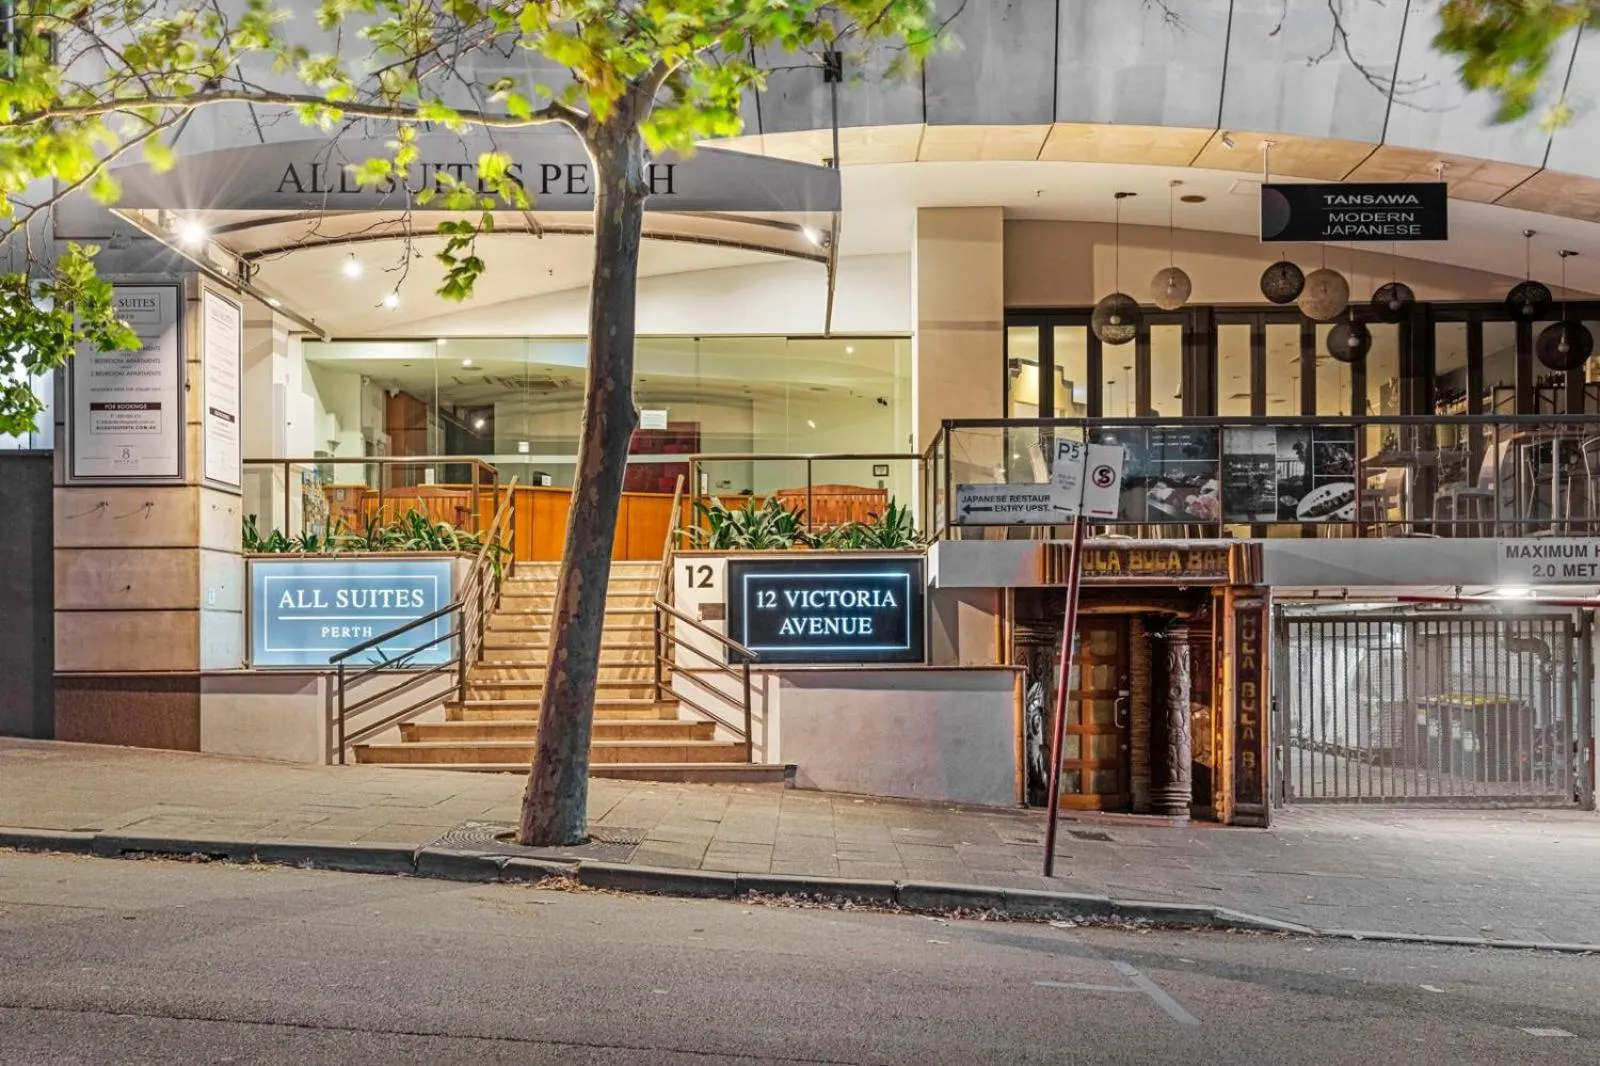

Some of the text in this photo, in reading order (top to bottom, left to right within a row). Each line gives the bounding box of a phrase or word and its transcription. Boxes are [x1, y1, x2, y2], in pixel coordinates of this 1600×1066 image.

[275, 162, 362, 194] ALL
[538, 162, 678, 193] PEH
[1323, 194, 1420, 205] TANSAWA
[1328, 212, 1415, 223] MODERN
[1322, 224, 1422, 236] JAPANESE
[118, 298, 156, 308] SUITES
[961, 494, 1008, 504] JAPANESE
[994, 504, 1023, 513] ENTRY
[1506, 544, 1588, 559] MAXIMUM
[1082, 550, 1121, 571] ULA
[1129, 550, 1182, 571] BULA
[684, 564, 715, 589] 12
[1532, 564, 1556, 578] 2.0
[278, 589, 425, 609] ALL SUITES
[756, 590, 898, 609] 12 VICTORIA
[321, 626, 373, 638] PERTH
[778, 617, 874, 636] AVENUE
[1241, 615, 1256, 670] HULA
[1241, 682, 1257, 741] BULA
